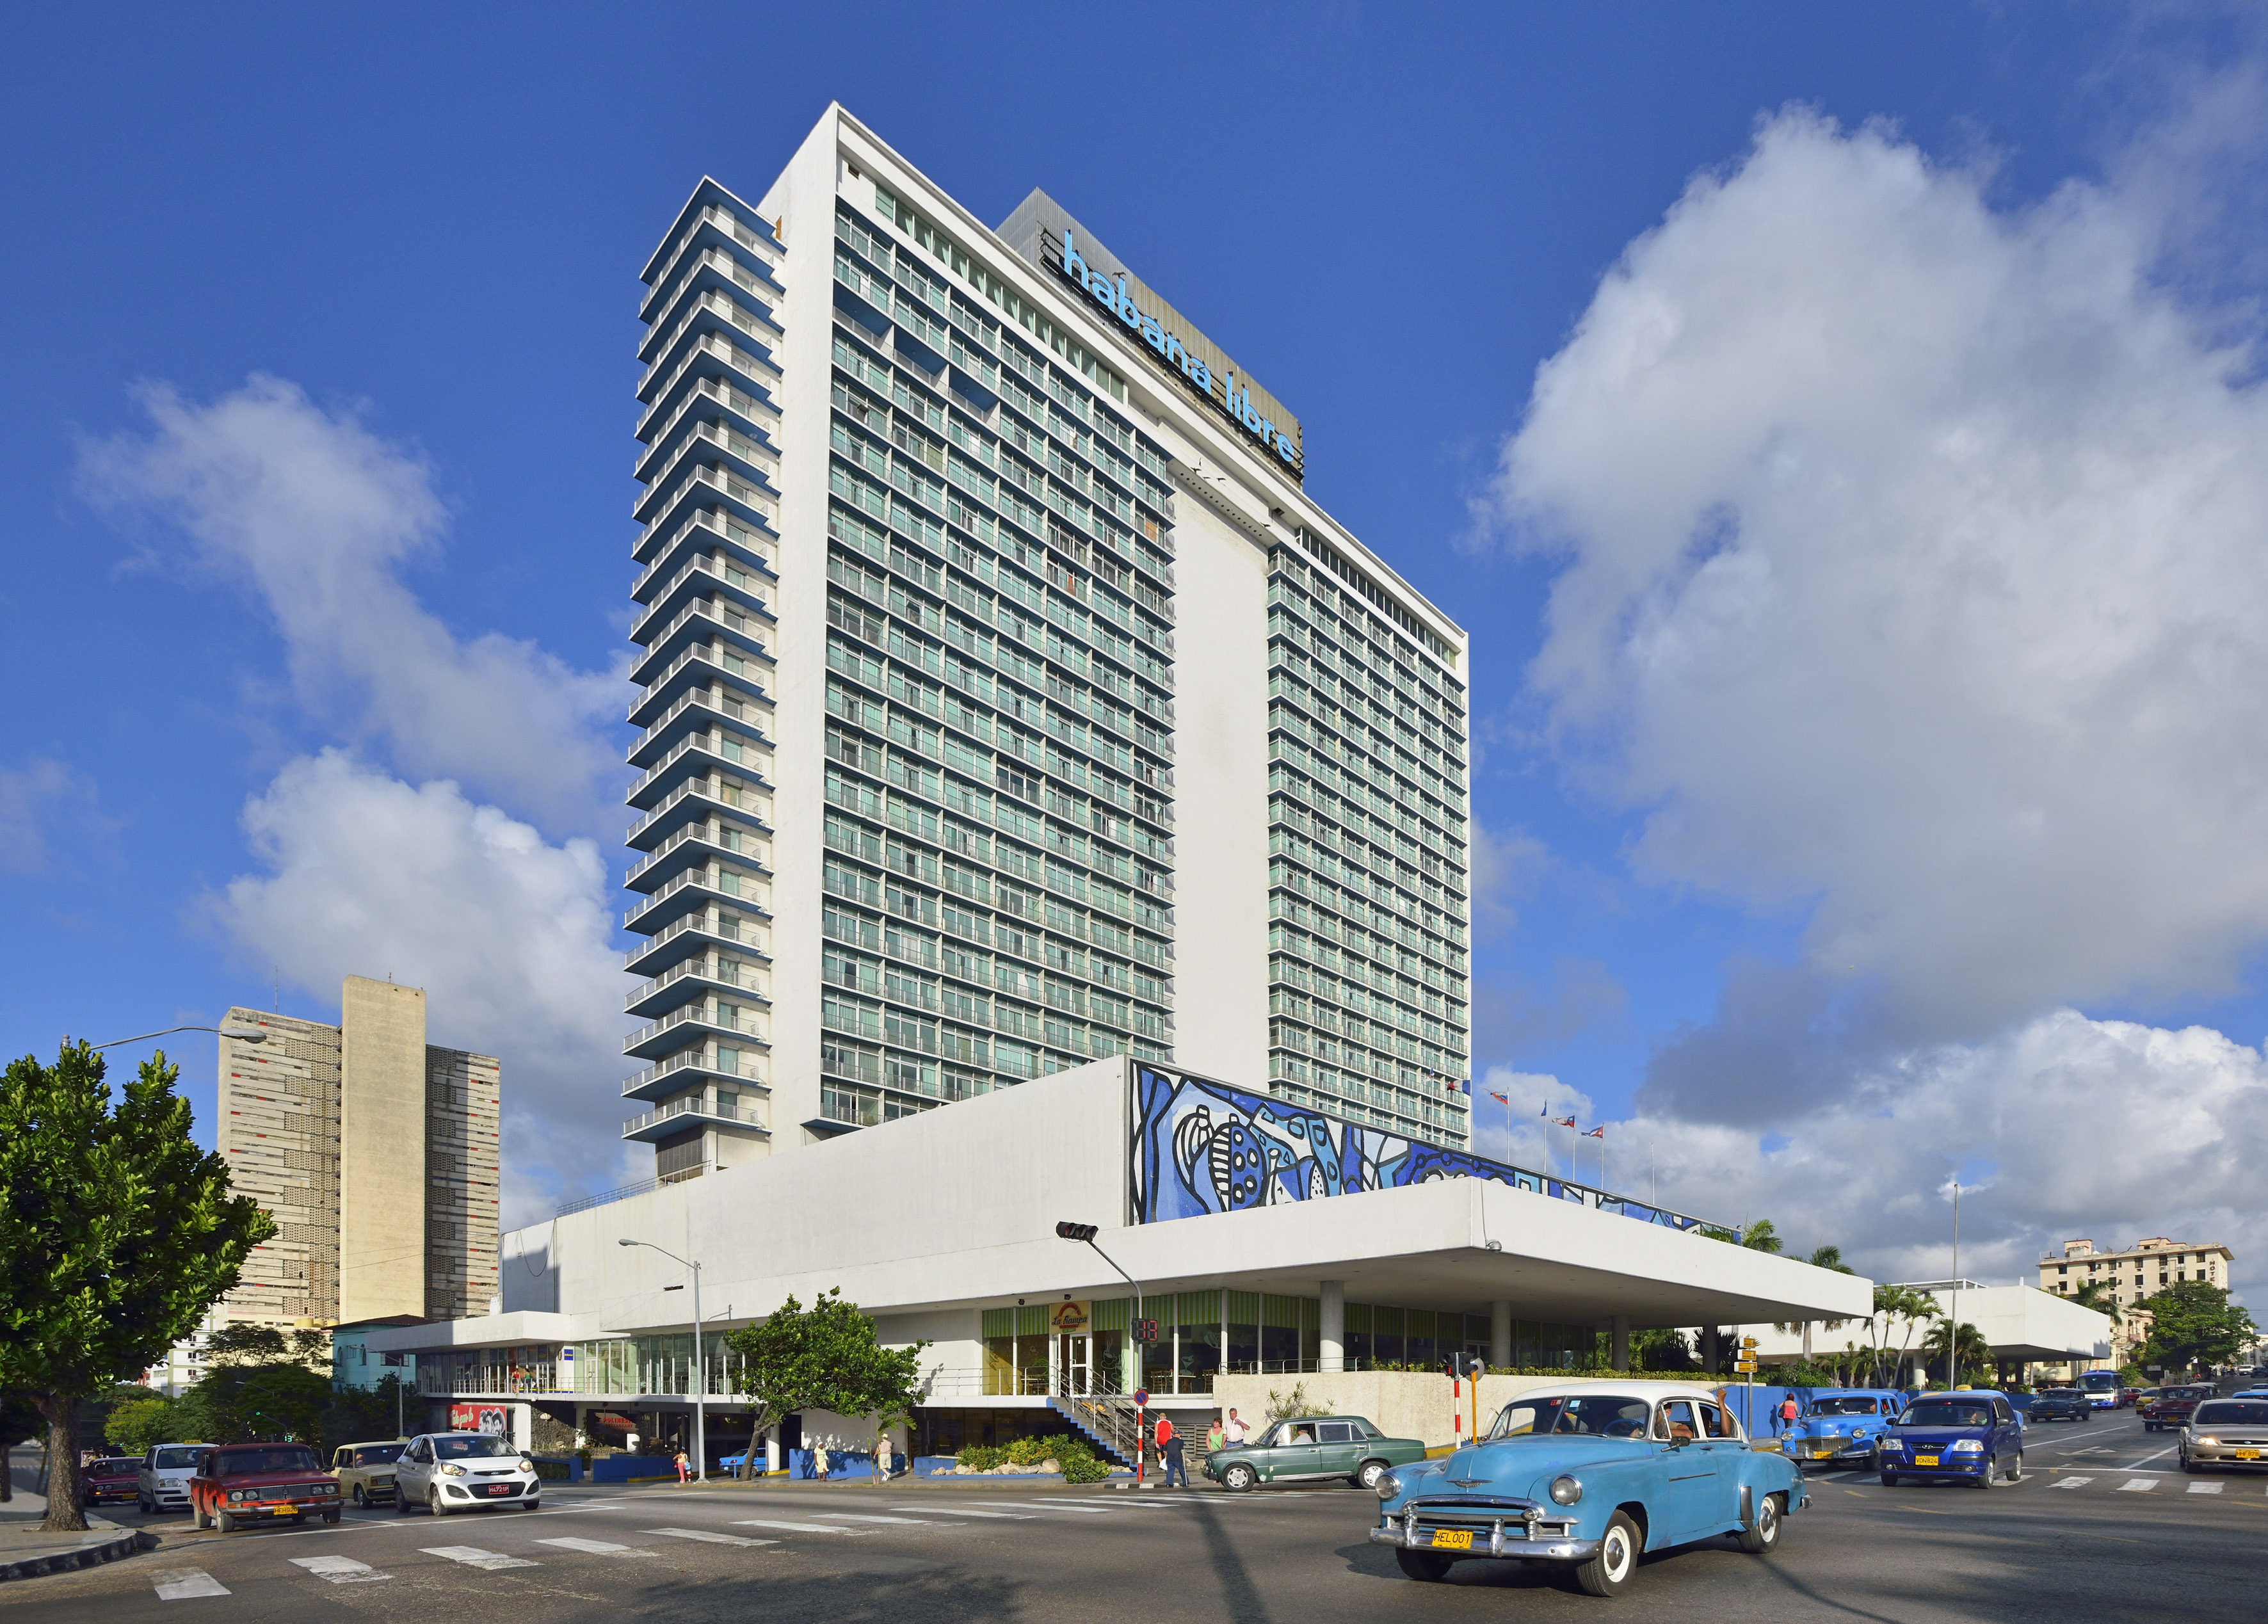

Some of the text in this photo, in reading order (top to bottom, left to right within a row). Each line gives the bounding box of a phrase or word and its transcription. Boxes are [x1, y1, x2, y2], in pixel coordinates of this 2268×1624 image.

[1064, 229, 1294, 463] habana libre
[1052, 1315, 1087, 1326] La Rampa
[1143, 1320, 1157, 1341] 13
[468, 1407, 474, 1422] lo
[1434, 1532, 1470, 1544] HEL001
